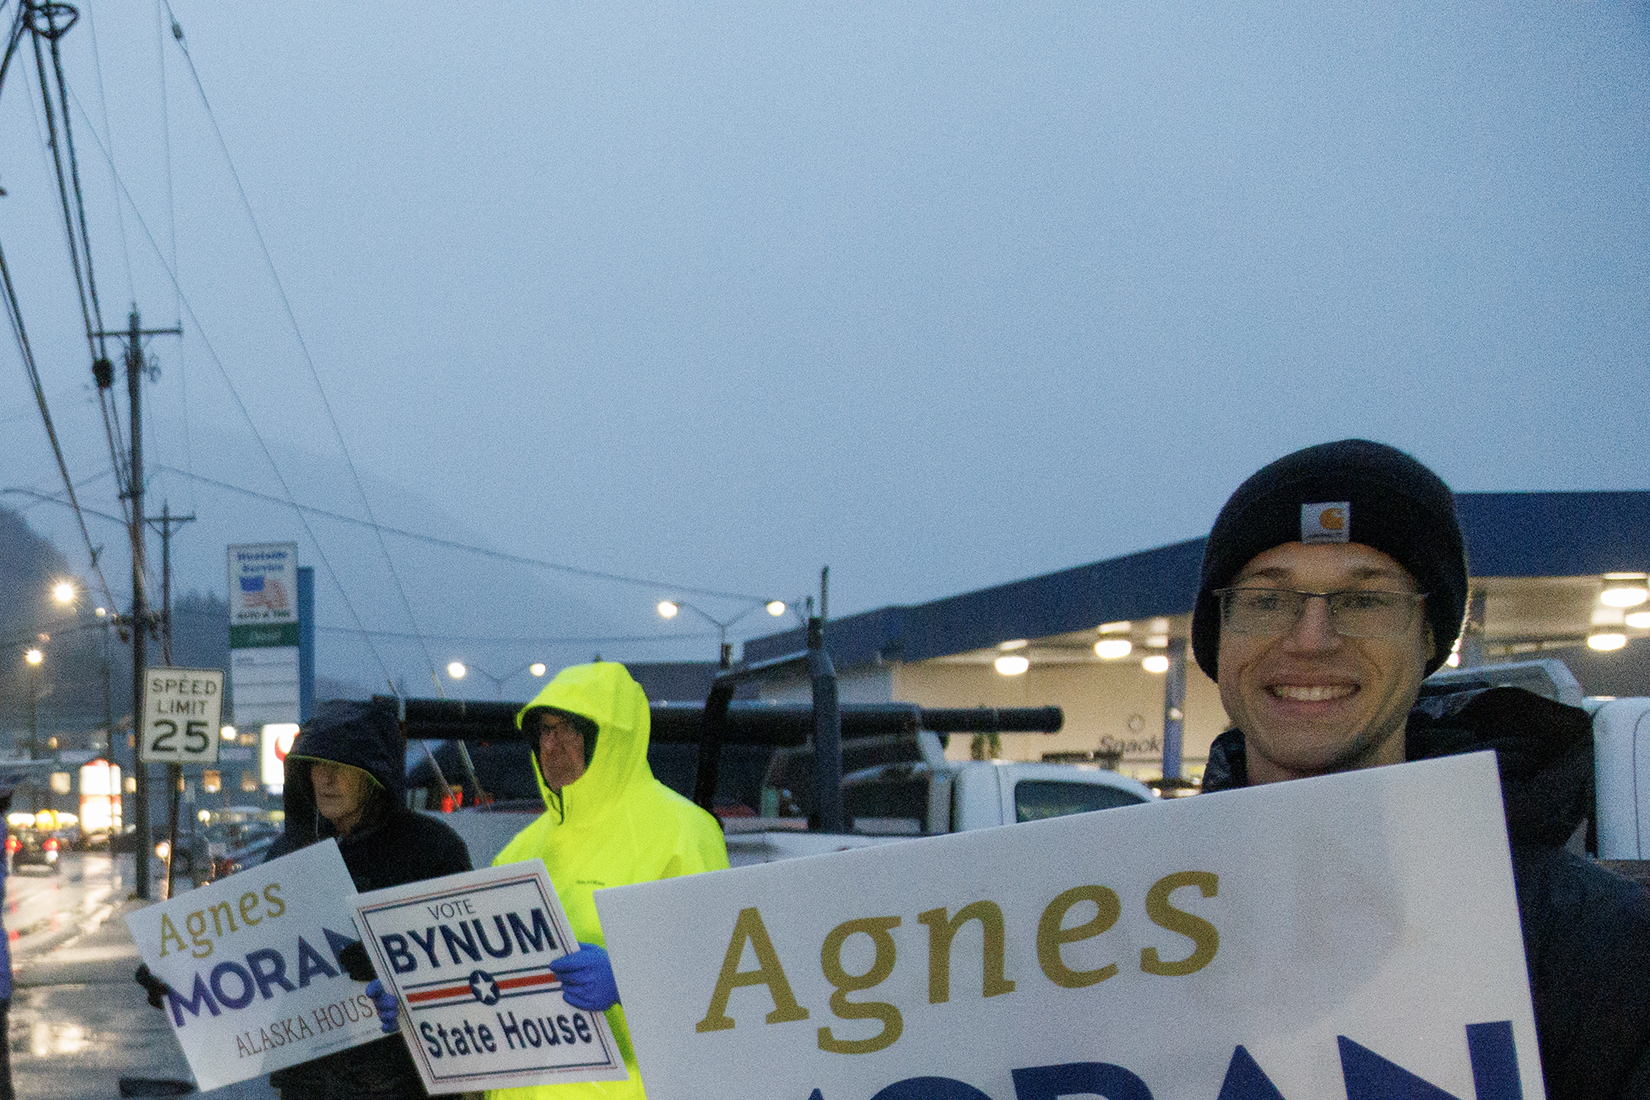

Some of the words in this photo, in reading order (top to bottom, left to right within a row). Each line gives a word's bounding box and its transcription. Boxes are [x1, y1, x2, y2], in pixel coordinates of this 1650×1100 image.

[152, 678, 217, 696] SPEED
[156, 700, 209, 715] LIMIT
[151, 719, 210, 753] 25
[159, 883, 286, 959] Agnes
[427, 899, 477, 921] VOTE
[379, 907, 558, 975] BYNUM
[695, 870, 1221, 1054] Agnes
[235, 1016, 313, 1059] ALASKA
[312, 994, 373, 1033] HOUS
[419, 1019, 497, 1059] State
[496, 1011, 593, 1050] House
